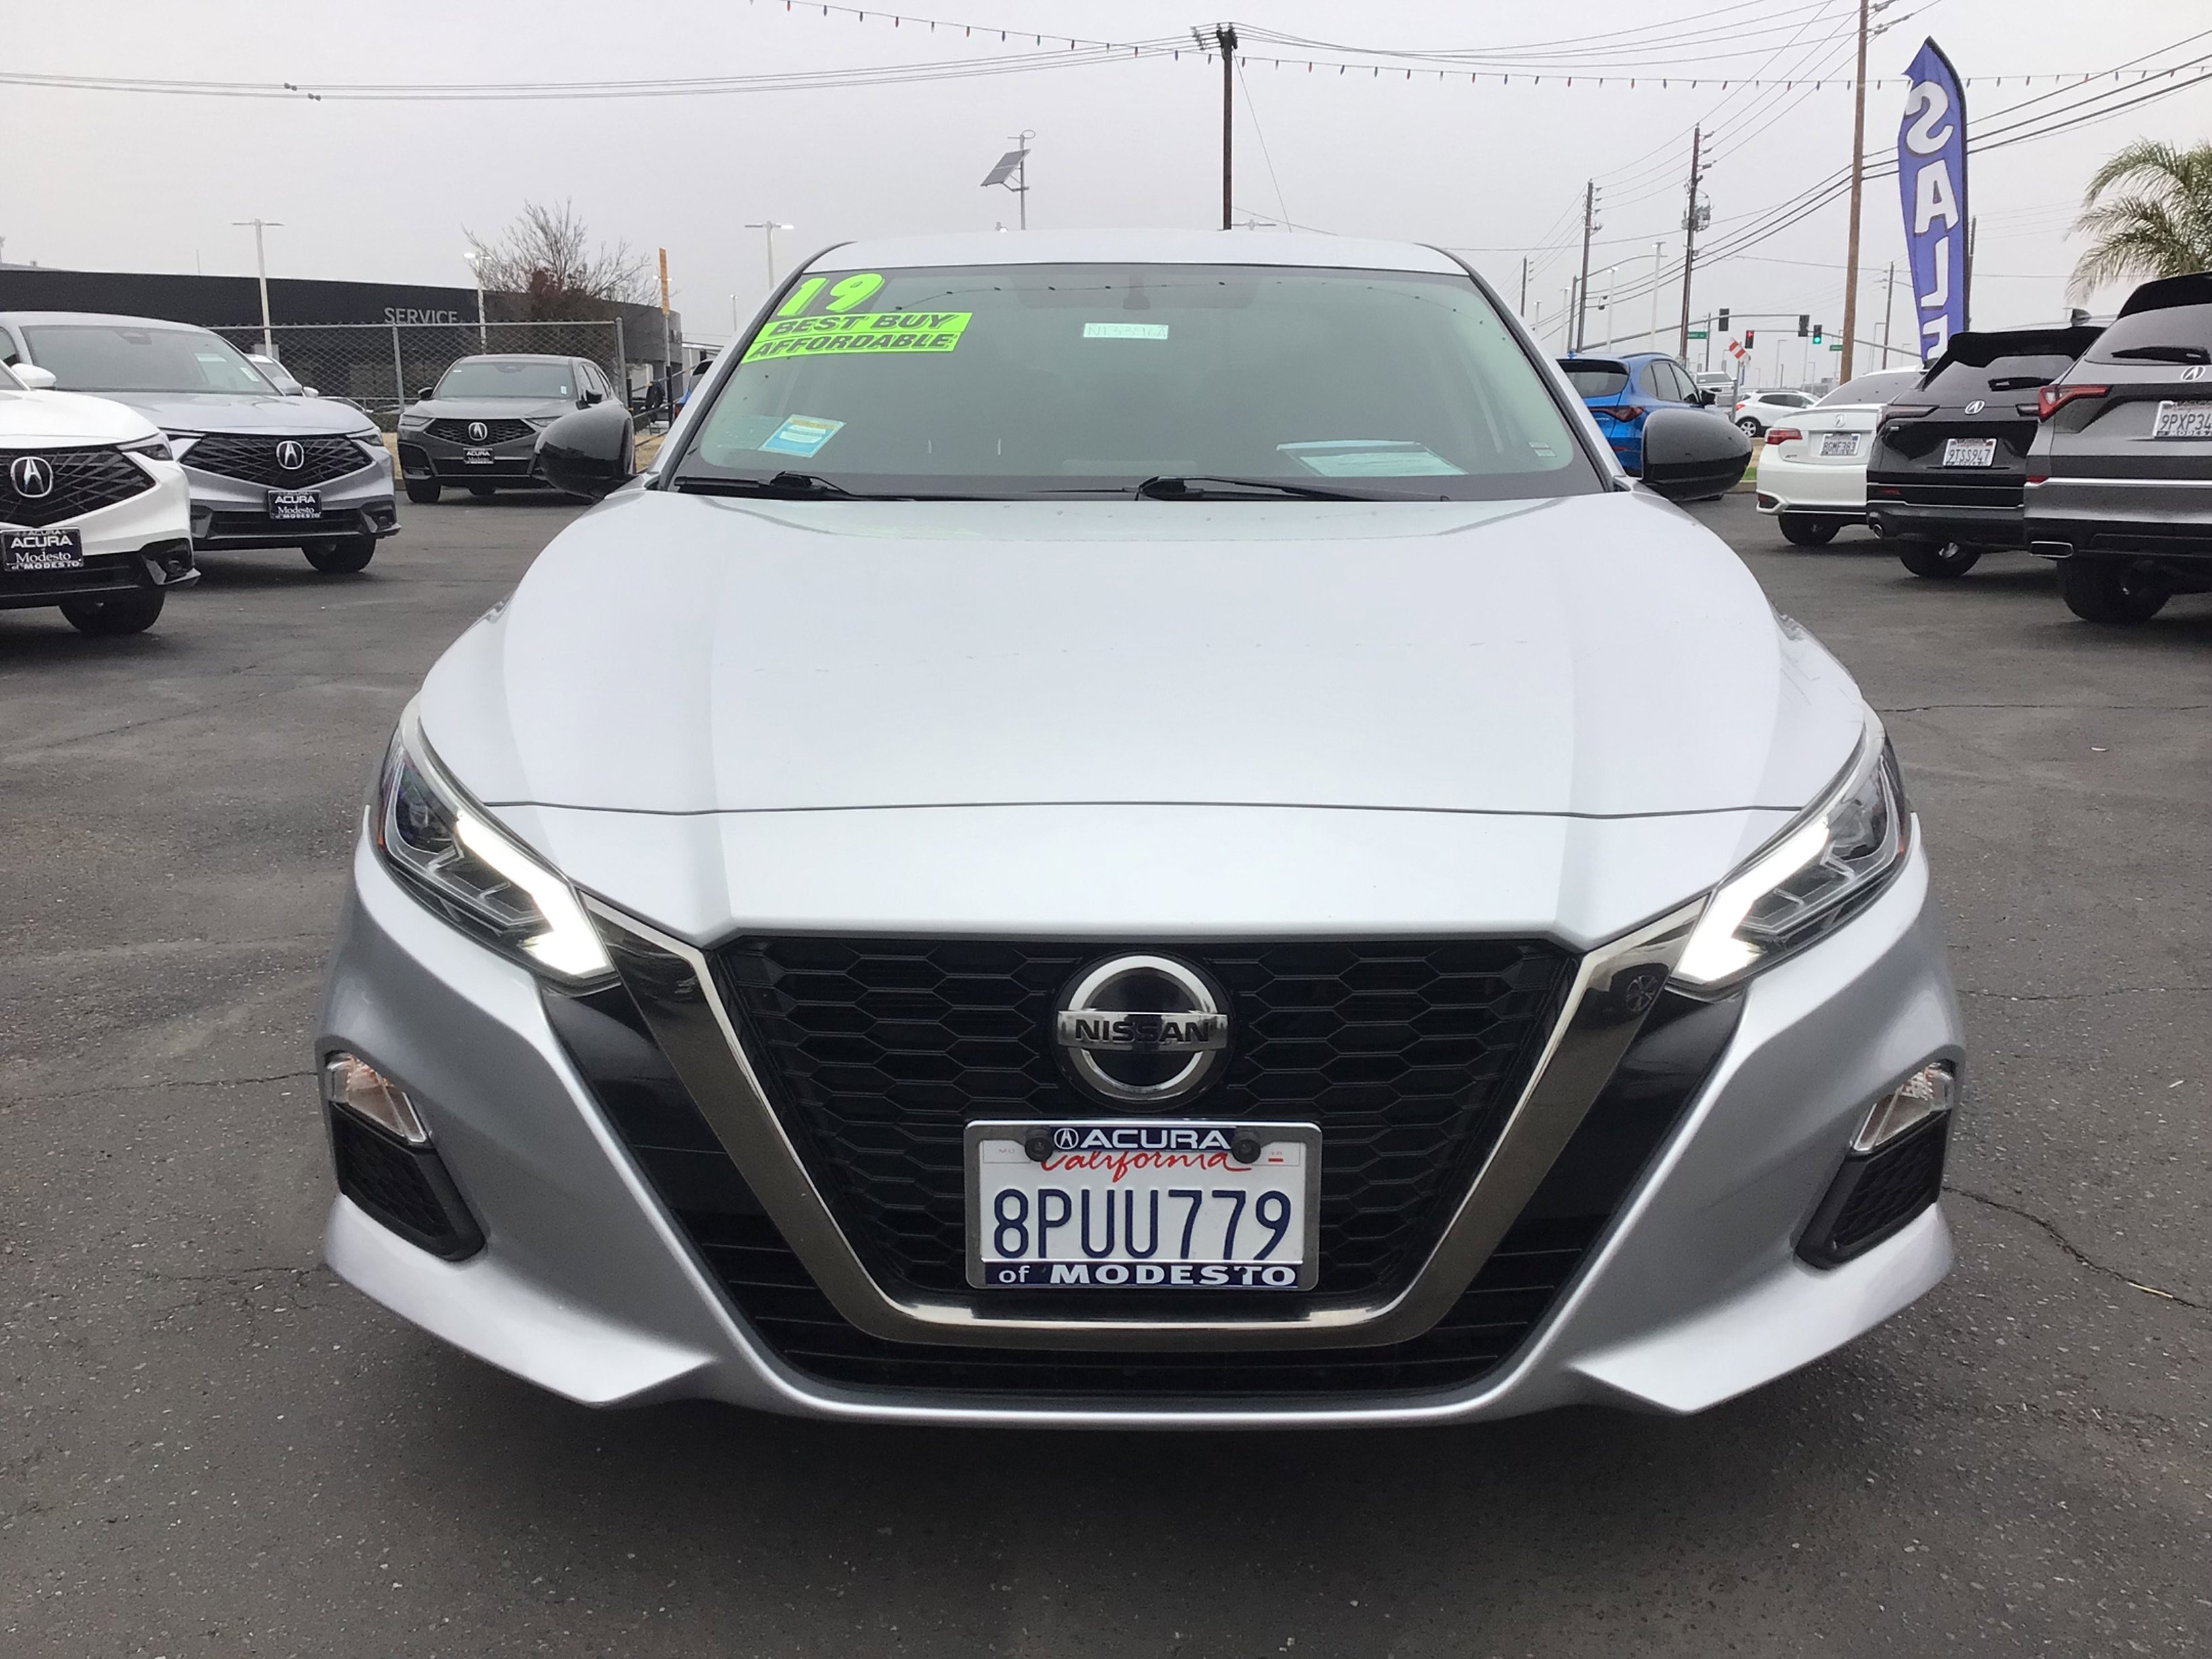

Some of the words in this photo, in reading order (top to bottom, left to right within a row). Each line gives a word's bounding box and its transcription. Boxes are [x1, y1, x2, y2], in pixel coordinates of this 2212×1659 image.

[776, 272, 885, 317] 19
[384, 307, 457, 324] SERVICE
[768, 315, 869, 337] BEST
[870, 314, 956, 330] BUY
[747, 333, 956, 360] AFFORDABLE
[1949, 449, 1990, 462] 9TSS947
[274, 495, 316, 504] ACURA
[10, 535, 73, 549] ACURA
[15, 551, 71, 564] Modesto
[1074, 1019, 1210, 1044] NISSAN
[1080, 1128, 1231, 1149] ACURA
[993, 1188, 1292, 1261] 8PUU779
[998, 1265, 1029, 1284] of
[1049, 1264, 1296, 1287] MODESTO
